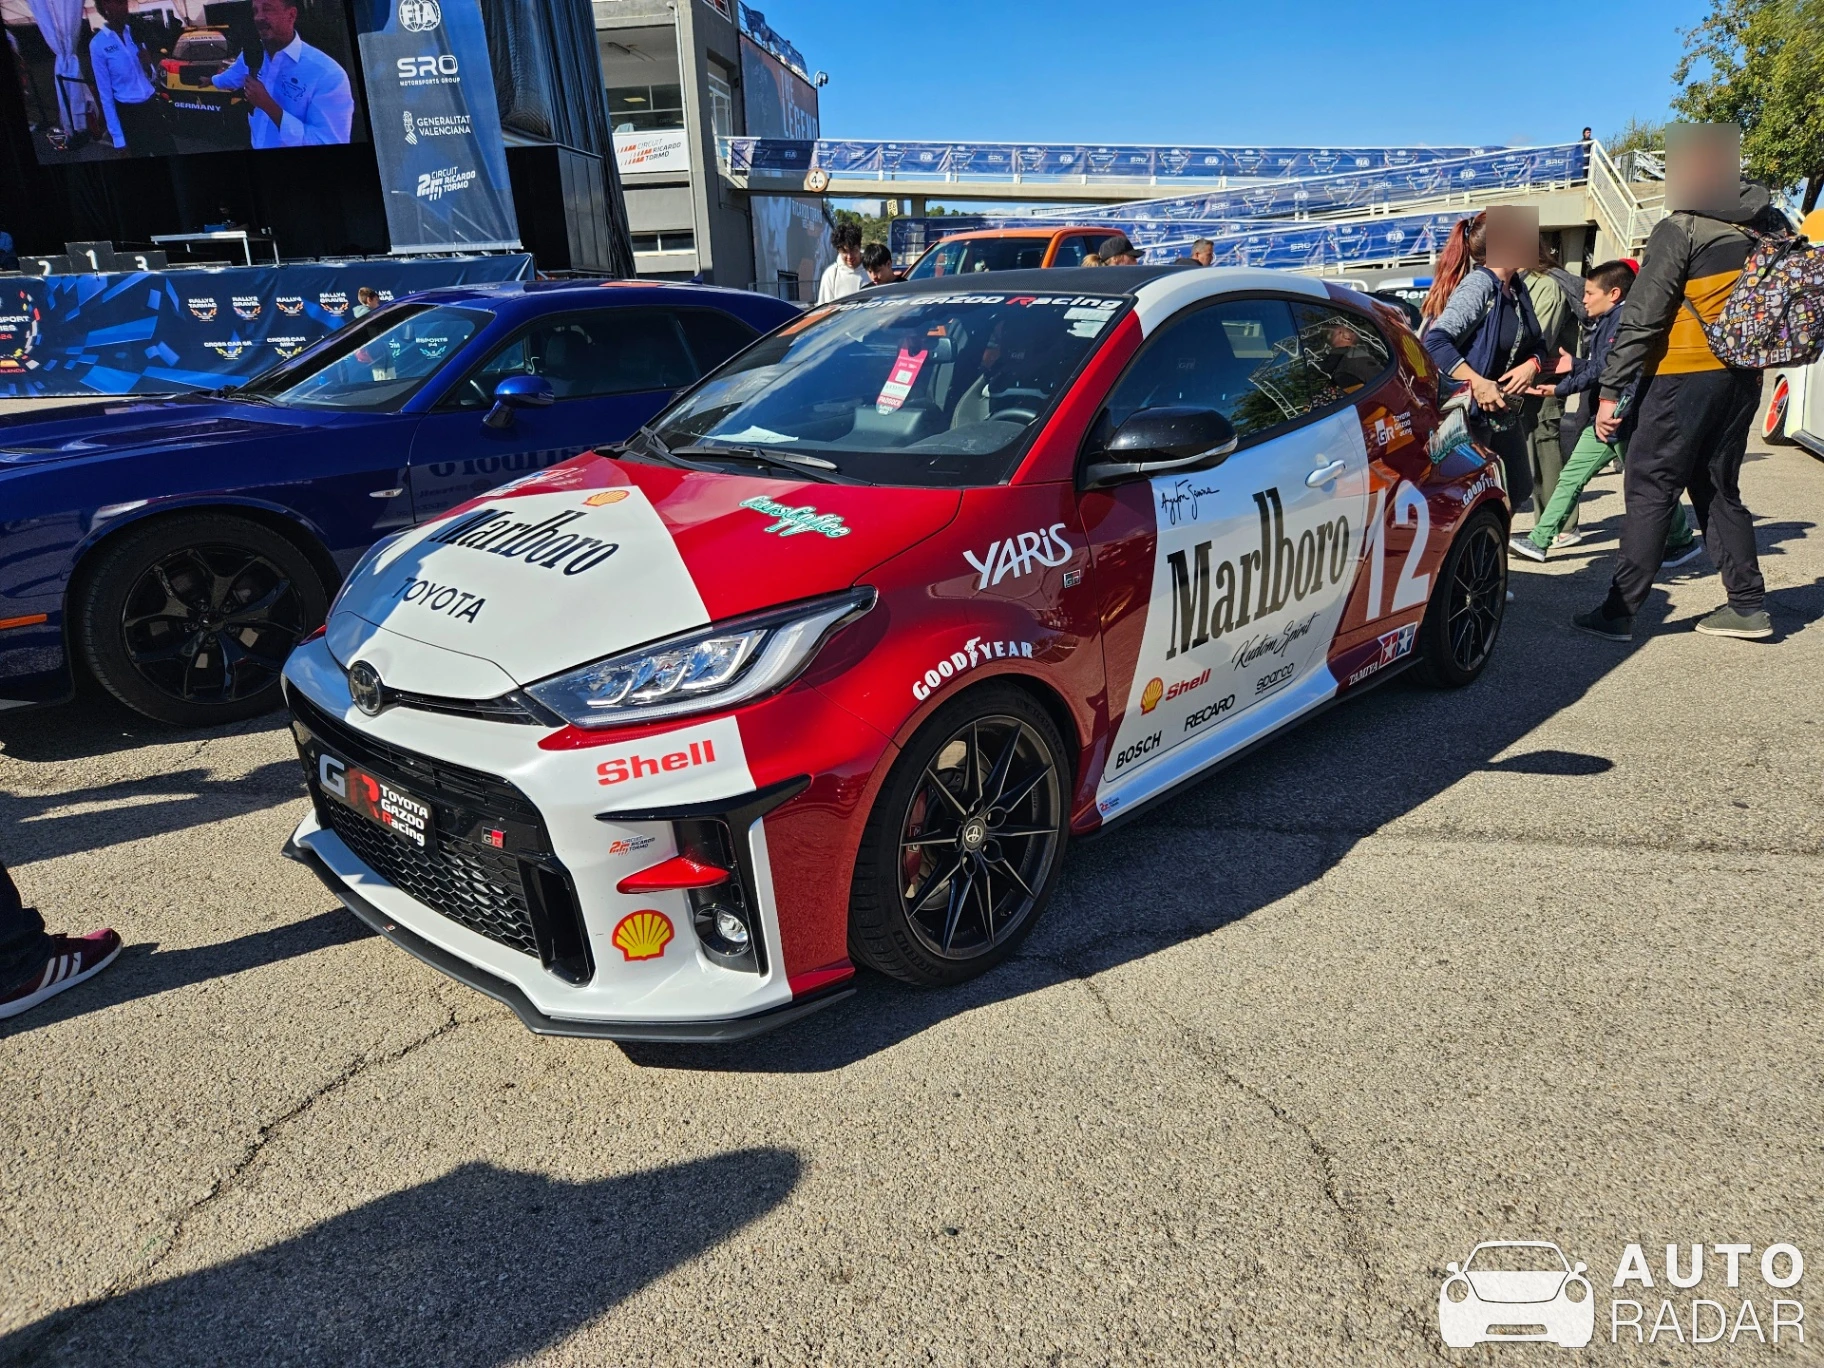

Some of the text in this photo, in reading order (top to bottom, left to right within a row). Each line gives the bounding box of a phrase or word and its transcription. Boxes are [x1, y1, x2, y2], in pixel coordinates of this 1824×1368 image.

[403, 8, 437, 25] FIA
[397, 55, 458, 77] SRO
[400, 78, 440, 86] MOTORSPORTS
[174, 102, 221, 112] GERMANY
[417, 115, 470, 127] GENERALITAT
[419, 125, 471, 136] VALENCIANA
[646, 151, 669, 161] TORMO
[653, 142, 681, 153] RICARDO
[432, 167, 458, 179] CIRCUIT
[444, 170, 476, 184] RICARDO
[811, 176, 817, 184] 4
[443, 181, 468, 192] TORMO
[1290, 243, 1310, 251] SRO
[86, 250, 98, 270] 1
[910, 296, 1006, 305] GAZOO
[1006, 297, 1123, 310] Racing
[428, 508, 620, 577] Marlboro
[1364, 479, 1430, 622] 12
[1166, 487, 1349, 661] Marlboro
[392, 576, 486, 624] TOYOTA
[912, 637, 1033, 701] GOODYEAR
[1255, 662, 1294, 694] sparco
[1165, 668, 1211, 701] Shell
[1184, 694, 1236, 732] RECARO
[1116, 730, 1162, 769] BOSCH
[596, 740, 716, 786] Shell
[319, 753, 379, 819] GR
[380, 783, 428, 819] TOYOTA
[381, 799, 425, 830] GAZOO
[382, 812, 425, 847] Racing
[483, 833, 503, 847] GR
[631, 837, 656, 846] RICARDO
